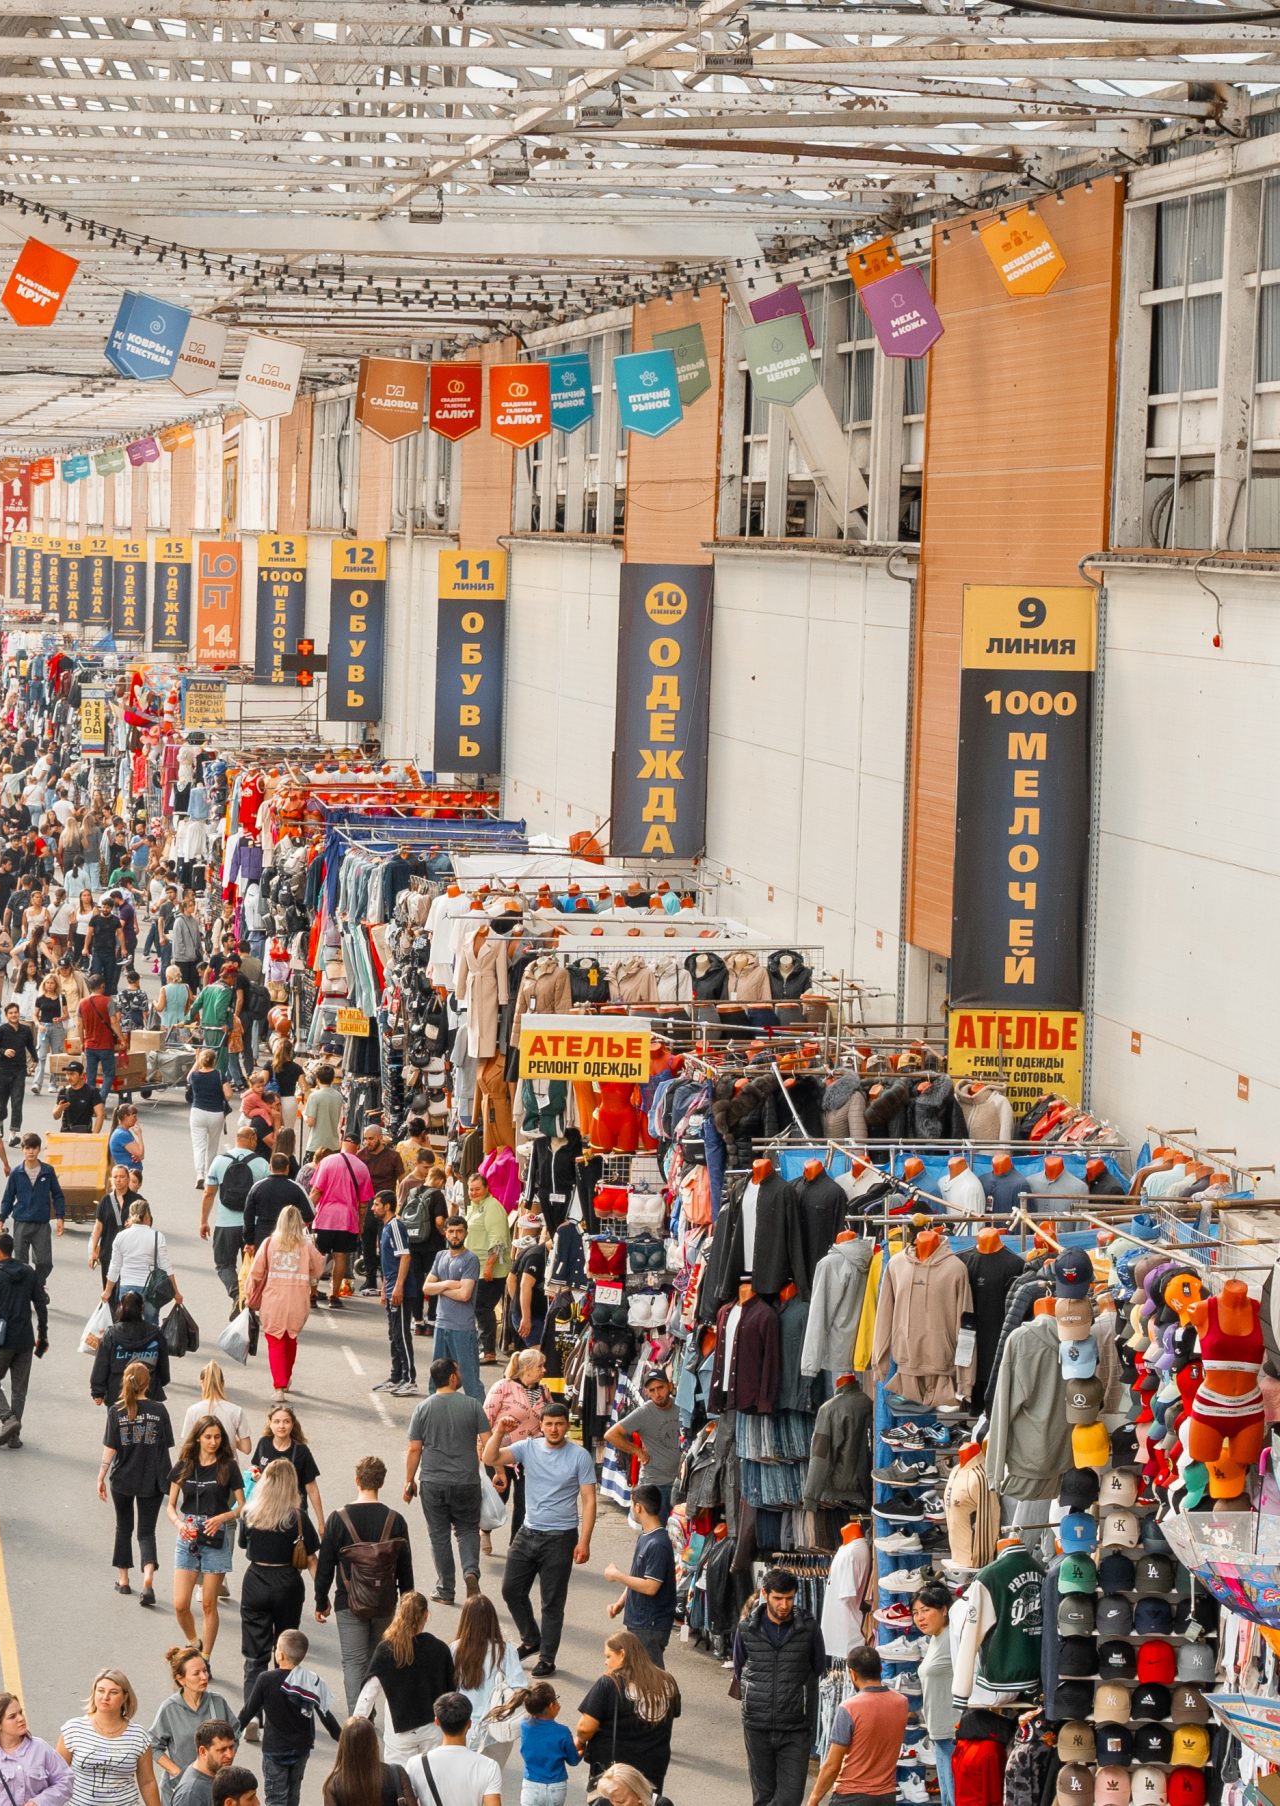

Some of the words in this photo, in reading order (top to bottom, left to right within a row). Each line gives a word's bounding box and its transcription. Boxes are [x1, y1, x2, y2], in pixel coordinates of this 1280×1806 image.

[1002, 241, 1050, 276] ВЕЩЕВОЙ
[1006, 251, 1056, 283] КОМПЛЕКС
[16, 273, 60, 301] ПАЛЬТОВЫЙ
[16, 284, 50, 308] КРУГ
[891, 310, 920, 327] МЕХА
[899, 318, 927, 335] КОЖА
[127, 332, 166, 351] КОВРЫ
[126, 343, 171, 366] ТЕКСТИЛЬ
[178, 352, 215, 369] АДОВОД
[755, 354, 808, 376] САДОВЫЙ
[246, 374, 291, 392] САДОВОД
[678, 369, 699, 382] ЕНТР
[766, 367, 801, 382] ЦЕНТР
[551, 388, 586, 402] ПТИЧИЙ
[628, 388, 671, 403] ПТИЧИЙ
[370, 398, 418, 411] САДОВОД
[552, 398, 582, 411] РЫНОК
[632, 399, 670, 412] РЫНОК
[436, 408, 474, 419] САЛЮТ
[497, 414, 542, 425] САЛЮТ
[5, 517, 27, 532] 24
[92, 540, 106, 548] 17
[123, 544, 139, 553] 16
[165, 543, 182, 553] 15
[271, 541, 295, 555] 13
[346, 548, 374, 564] 12
[260, 571, 303, 582] 1000
[455, 560, 490, 580] 11
[48, 558, 60, 610] ОДЕЖДА
[67, 562, 80, 619] ОДЕЖДА
[92, 559, 104, 614] ОДЕЖДА
[452, 582, 494, 591] ЛИНИЯ
[122, 565, 136, 626] ОДЕЖДА
[164, 567, 180, 636] ОДЕЖДА
[653, 591, 681, 607] 10
[1018, 598, 1046, 629] 9
[203, 624, 232, 647] 14
[272, 585, 289, 683] МЕЛОЧЕЙ
[199, 649, 236, 660] ЛИНИЯ
[347, 590, 369, 707] ОБУВЬ
[986, 636, 1076, 656] ЛИНИЯ
[189, 683, 224, 691] АТЕЛЬЕ
[458, 612, 484, 757] ОБУВЬ
[984, 690, 1077, 716] 1000
[84, 701, 93, 734] АВТО
[93, 701, 102, 734] ЧЕХЛЫ
[637, 638, 684, 853] ОДЕЖДА
[1004, 733, 1047, 984] МЕЛОЧЕЙ
[955, 1015, 1077, 1050] АТЕЛЬЕ
[528, 1035, 642, 1058] АТЕЛЬЕ
[528, 1060, 579, 1075] РЕМОНТ
[584, 1062, 642, 1077] ОДЕЖДЫ
[1016, 1057, 1064, 1069] ОДЕЖДЫ
[1014, 1072, 1065, 1084] СОТОВЫХ,
[598, 1288, 618, 1301] 799
[1112, 1476, 1122, 1489] LA
[1072, 1565, 1083, 1578] LA
[1148, 1564, 1159, 1578] LA
[1008, 1571, 1044, 1592] PREMI
[1184, 1693, 1196, 1707] LA
[1070, 1777, 1082, 1790] LA
[1145, 1777, 1154, 1790] LA
